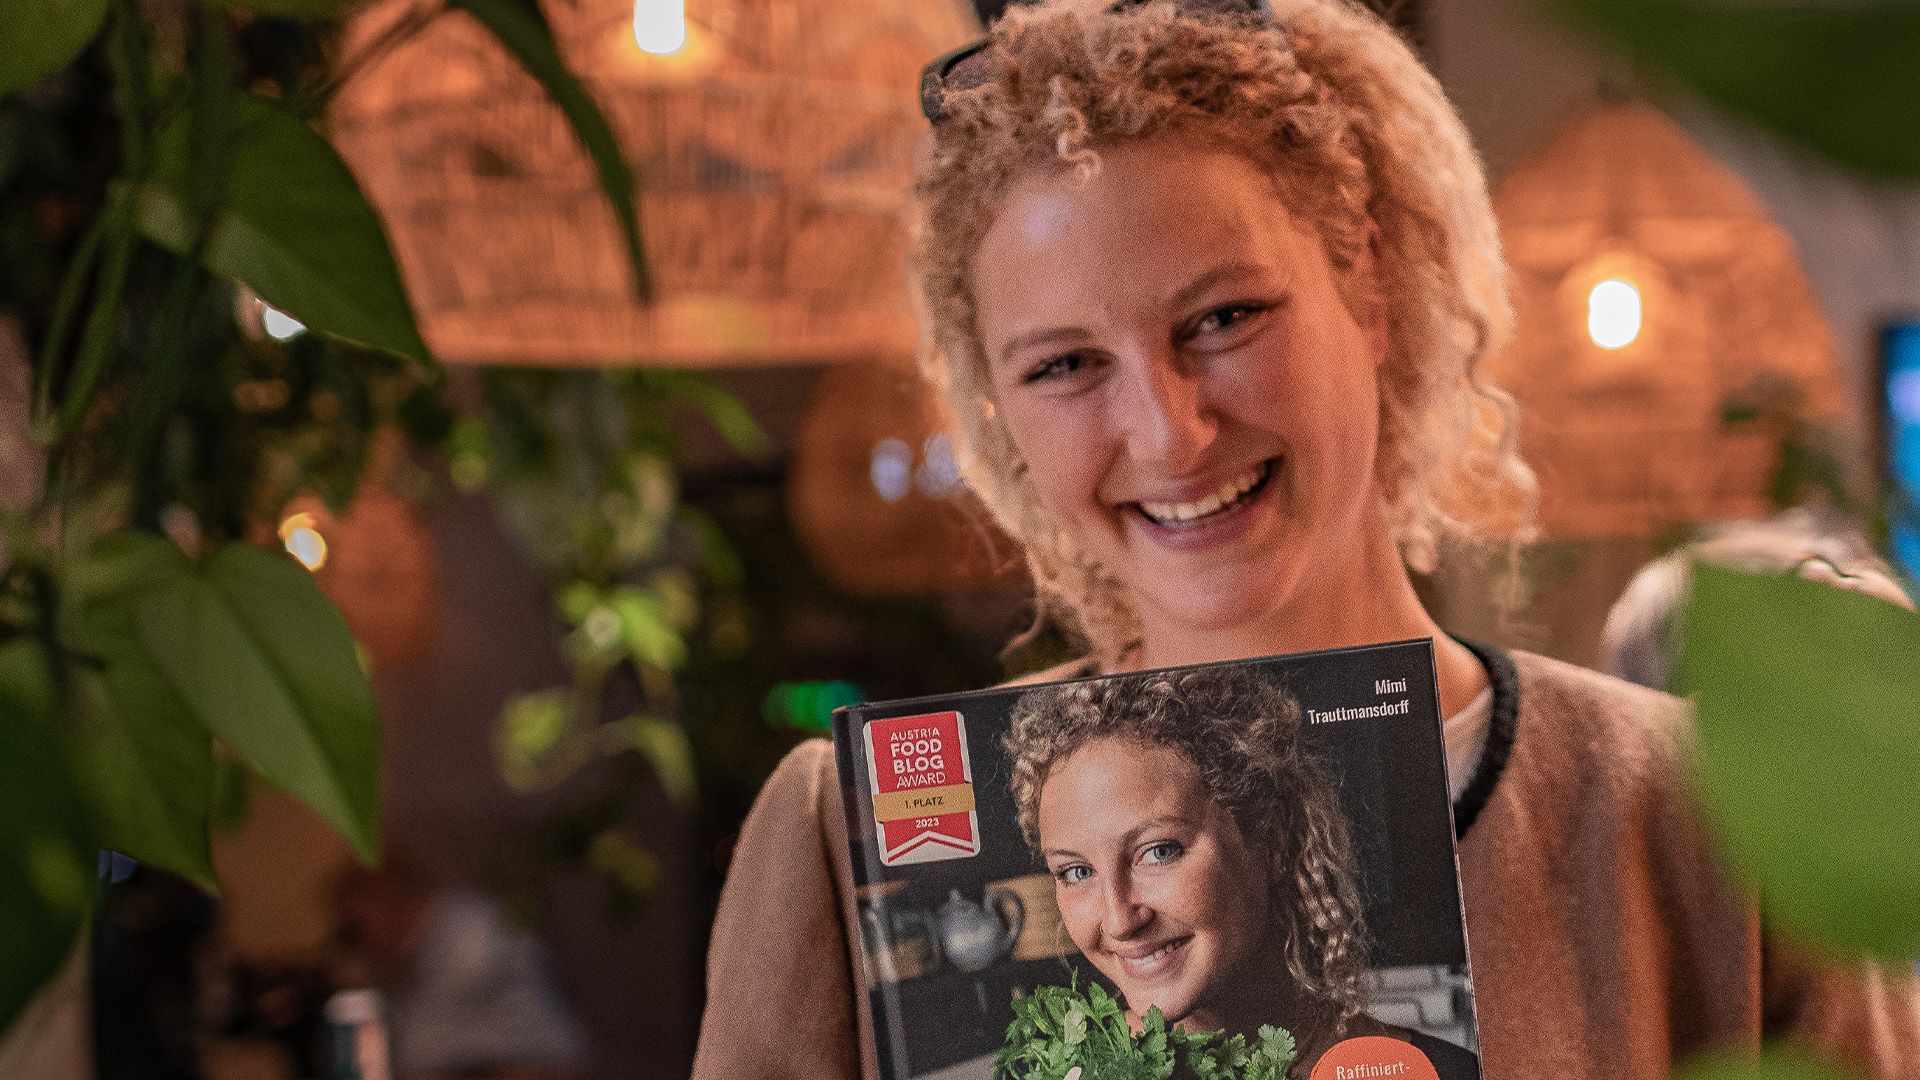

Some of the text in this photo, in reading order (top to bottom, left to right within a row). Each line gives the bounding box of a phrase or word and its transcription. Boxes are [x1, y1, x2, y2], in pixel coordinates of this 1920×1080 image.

[1375, 678, 1407, 695] Mimi
[1307, 699, 1409, 725] Trauttmansdorff
[890, 727, 940, 742] AUSTRIA
[891, 738, 942, 758] FOOD
[893, 754, 944, 774] BLOG
[896, 772, 946, 789] AWARD
[905, 796, 944, 809] 1. PLATZ
[915, 817, 939, 828] 2023
[1336, 1061, 1410, 1080] Raffiniert-
